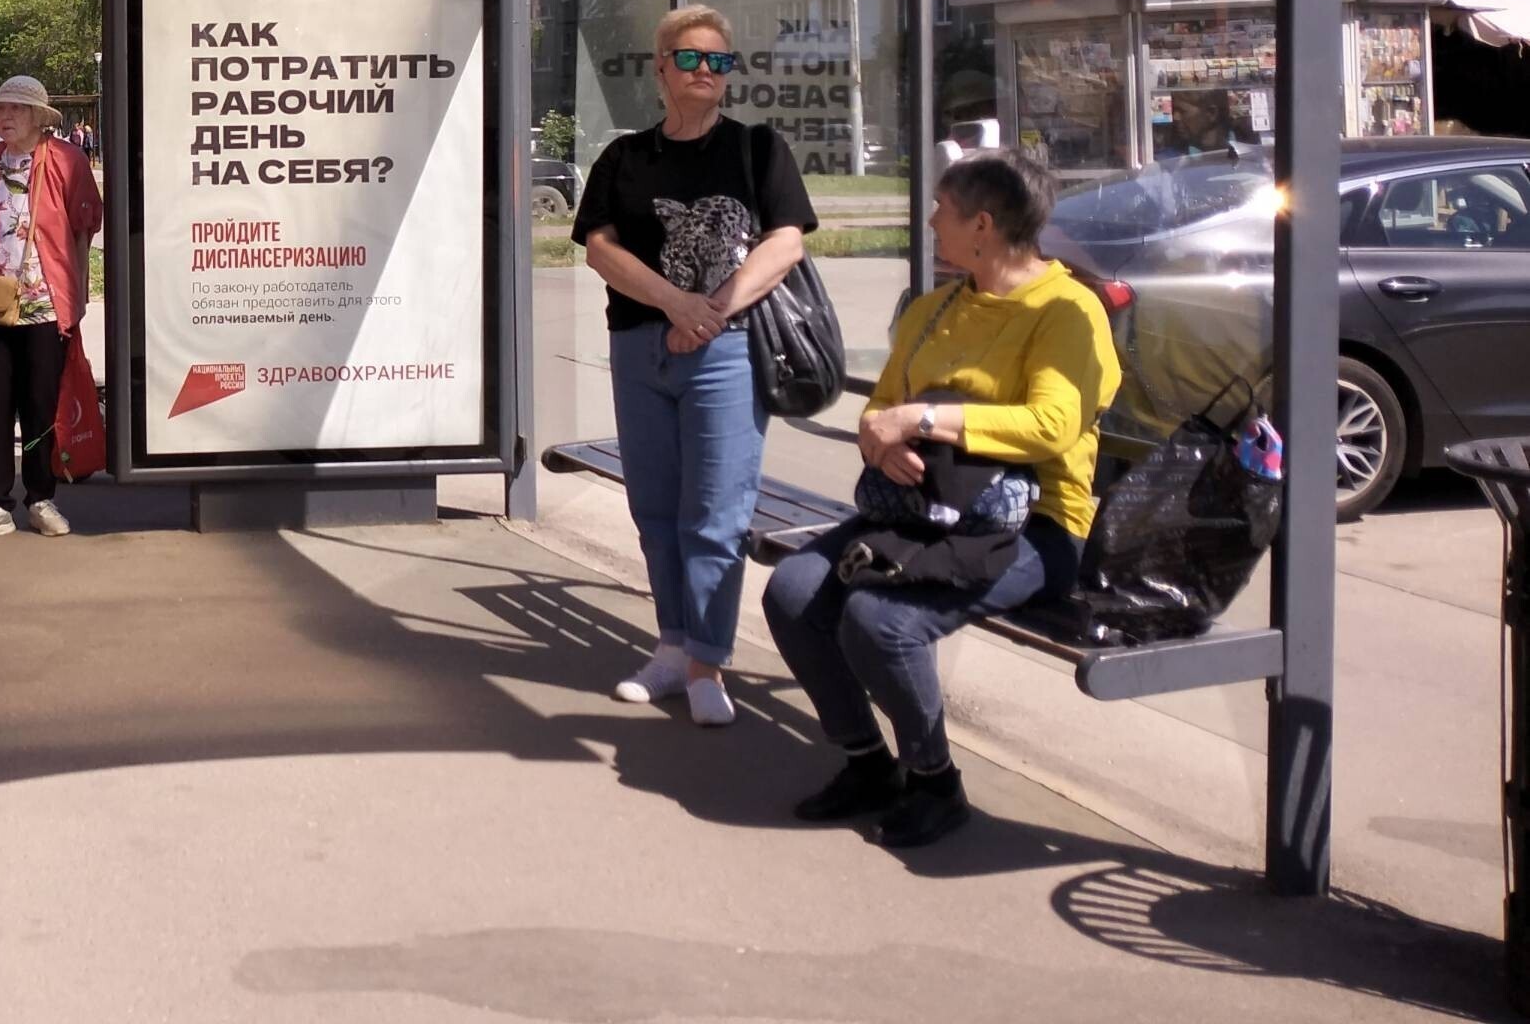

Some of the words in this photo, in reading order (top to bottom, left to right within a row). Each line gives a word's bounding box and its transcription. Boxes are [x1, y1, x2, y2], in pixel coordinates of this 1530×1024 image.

[191, 22, 279, 48] КАК
[191, 54, 456, 82] ПОТРАТИТЬ
[191, 81, 395, 116] РАБОЧИЙ
[190, 124, 306, 155] ДЕНЬ
[192, 160, 251, 186] НА
[258, 156, 394, 185] СЕБЯ?
[192, 218, 281, 245] ПРОЙДИТЕ
[191, 245, 367, 272] ДИСПАНСЕРИЗАЦИЮ
[192, 282, 210, 295] По
[213, 283, 259, 296] закону
[262, 280, 354, 295] работодатель
[191, 297, 239, 310] обязан
[242, 297, 335, 310] предоставить
[338, 296, 363, 308] для
[366, 295, 402, 306] этого
[192, 311, 295, 325] оплачиваемый
[299, 313, 336, 325] день.
[192, 364, 244, 374] НАЦИОНАЛЬНЫЕ
[214, 373, 245, 382] ПРОЕКТЫ
[257, 363, 455, 386] ЗДРАВООХРАНЕНИЕ
